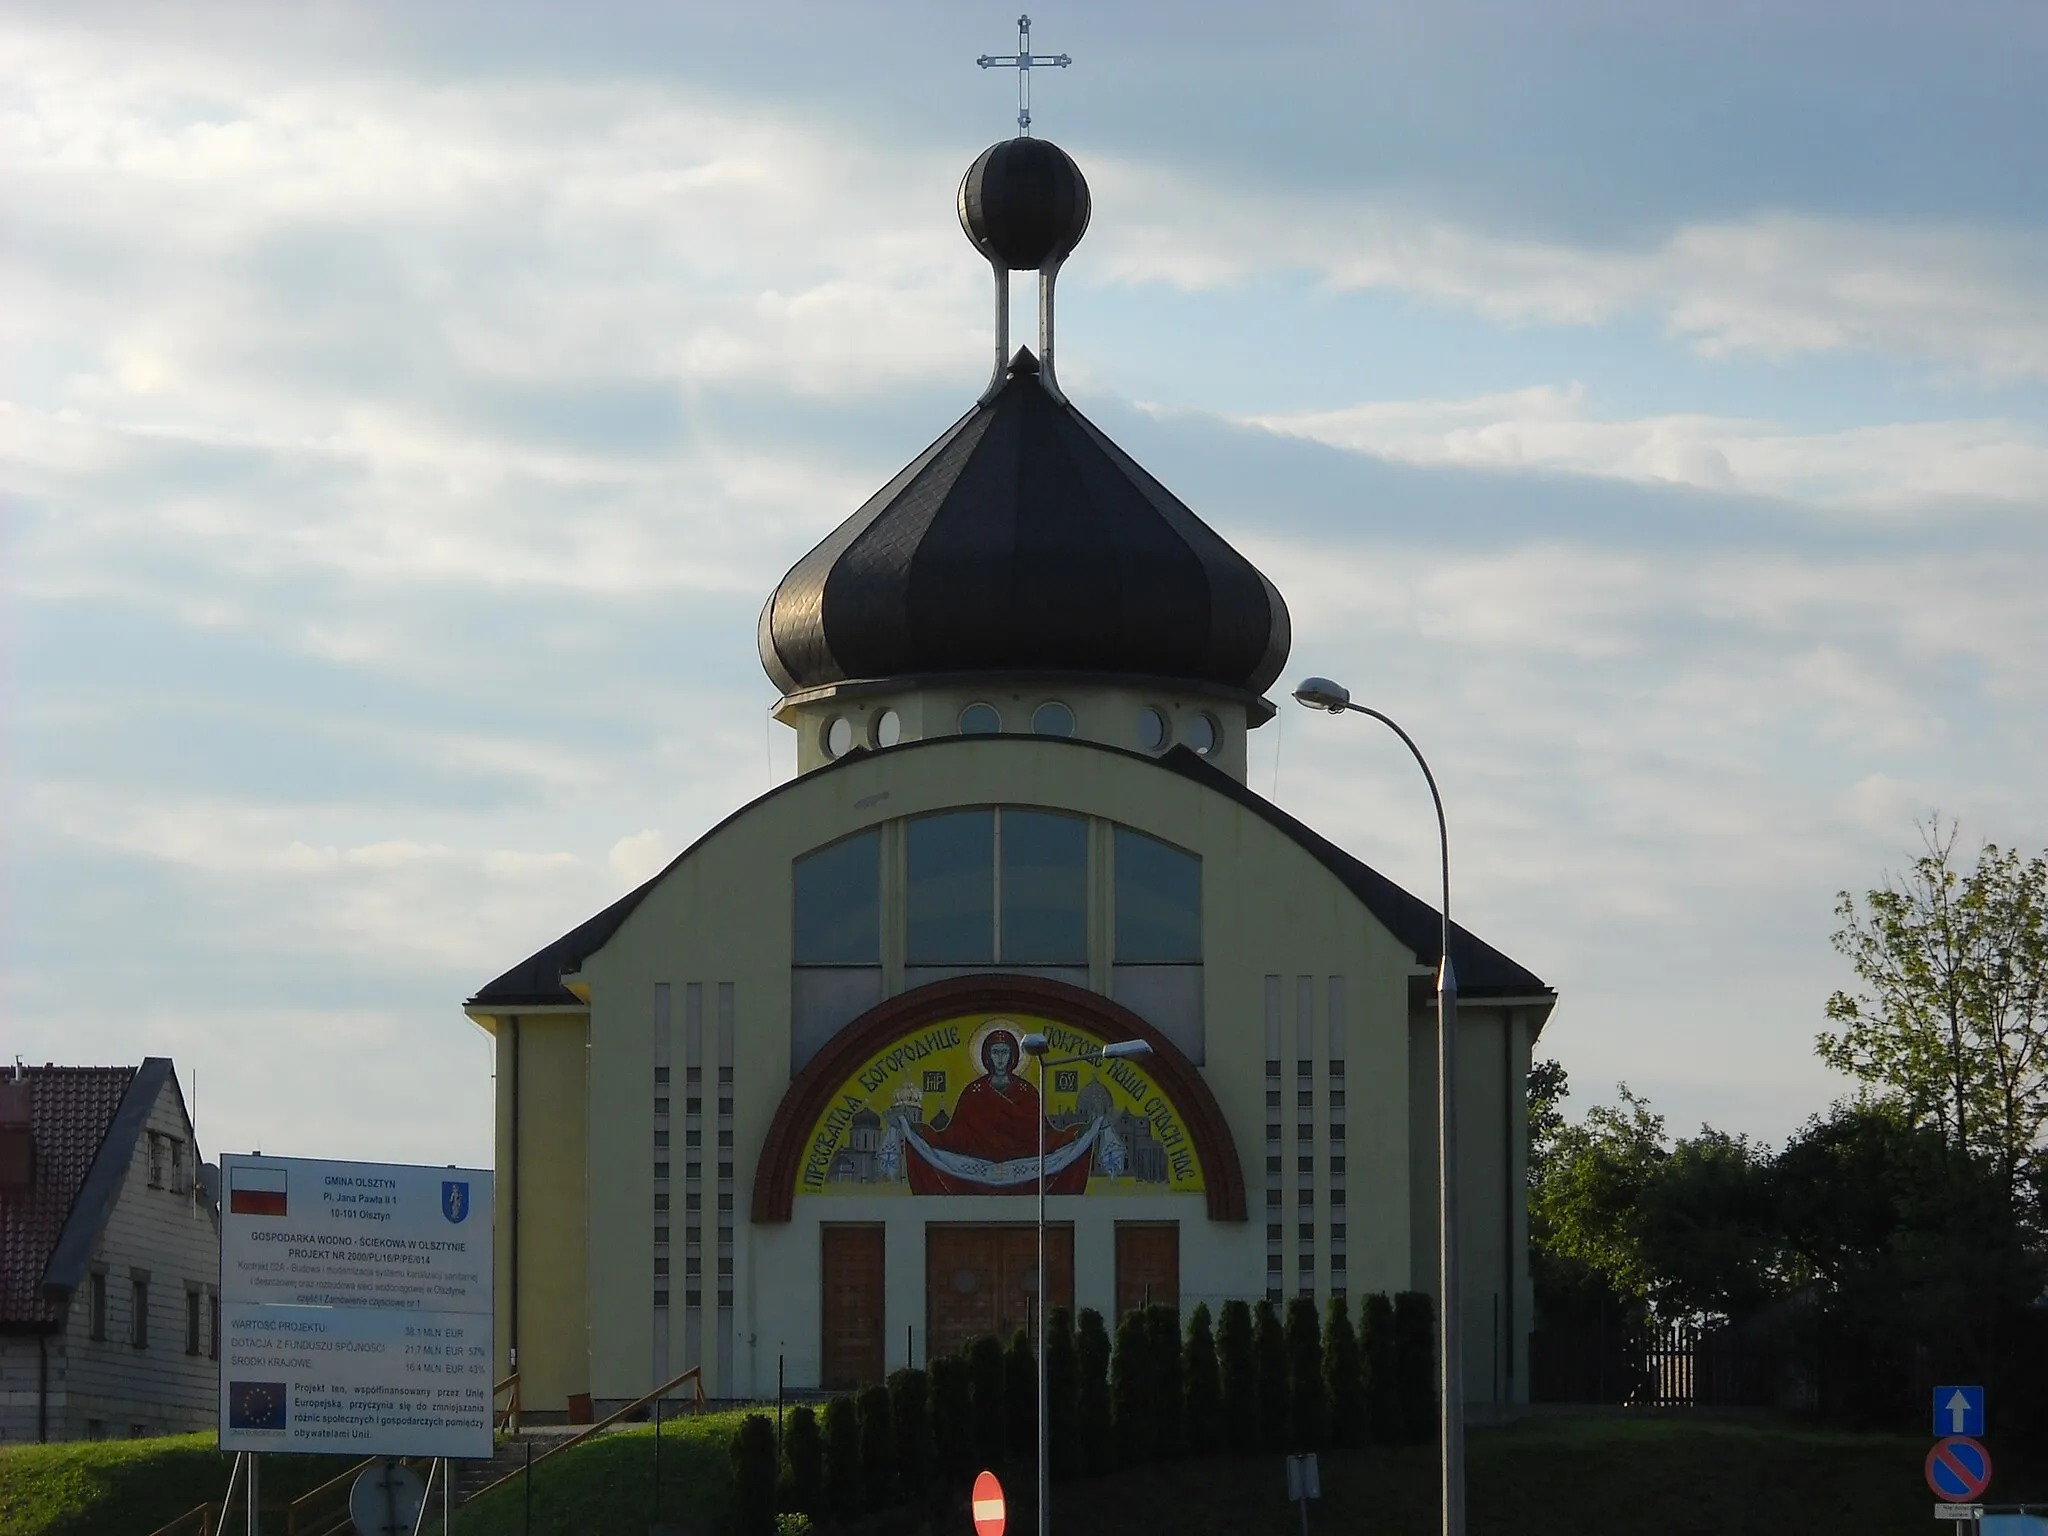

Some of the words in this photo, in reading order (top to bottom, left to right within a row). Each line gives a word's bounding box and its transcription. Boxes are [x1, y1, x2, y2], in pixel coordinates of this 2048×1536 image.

[325, 1177, 354, 1187] GMINA
[356, 1178, 396, 1188] OLSZTYN
[337, 1193, 356, 1202] Jana
[332, 1209, 357, 1218] 10-101
[360, 1210, 391, 1222] Olsztyn
[251, 1231, 316, 1244] GOSPODARKA
[317, 1235, 352, 1246] WODNO
[360, 1236, 406, 1249] ŚCIEKOWA
[408, 1240, 418, 1249] W
[419, 1241, 466, 1252] OLSZTYNIE
[289, 1248, 330, 1260] PROJEKT
[333, 1251, 345, 1260] NR
[424, 1328, 441, 1337] MLN
[446, 1329, 464, 1338] EUR
[231, 1338, 272, 1348] DOTACJA
[276, 1339, 282, 1350] Z
[285, 1340, 333, 1351] FUNDUSZU
[424, 1346, 441, 1355] MLN
[446, 1347, 464, 1356] EUR
[231, 1355, 266, 1367] ŚRODKI
[424, 1363, 441, 1373] MLN
[446, 1364, 464, 1373] EUR
[295, 1383, 325, 1394] Projekt
[354, 1385, 431, 1397] współfinansowany
[437, 1389, 460, 1398] przez
[350, 1401, 393, 1412] przyczynia
[416, 1402, 427, 1410] do
[432, 1403, 484, 1414] zmniejszania
[323, 1414, 374, 1426] społecznych
[381, 1416, 444, 1427] gospodarczych
[446, 1418, 484, 1429] pomiędzy
[295, 1429, 349, 1440] obywatelami
